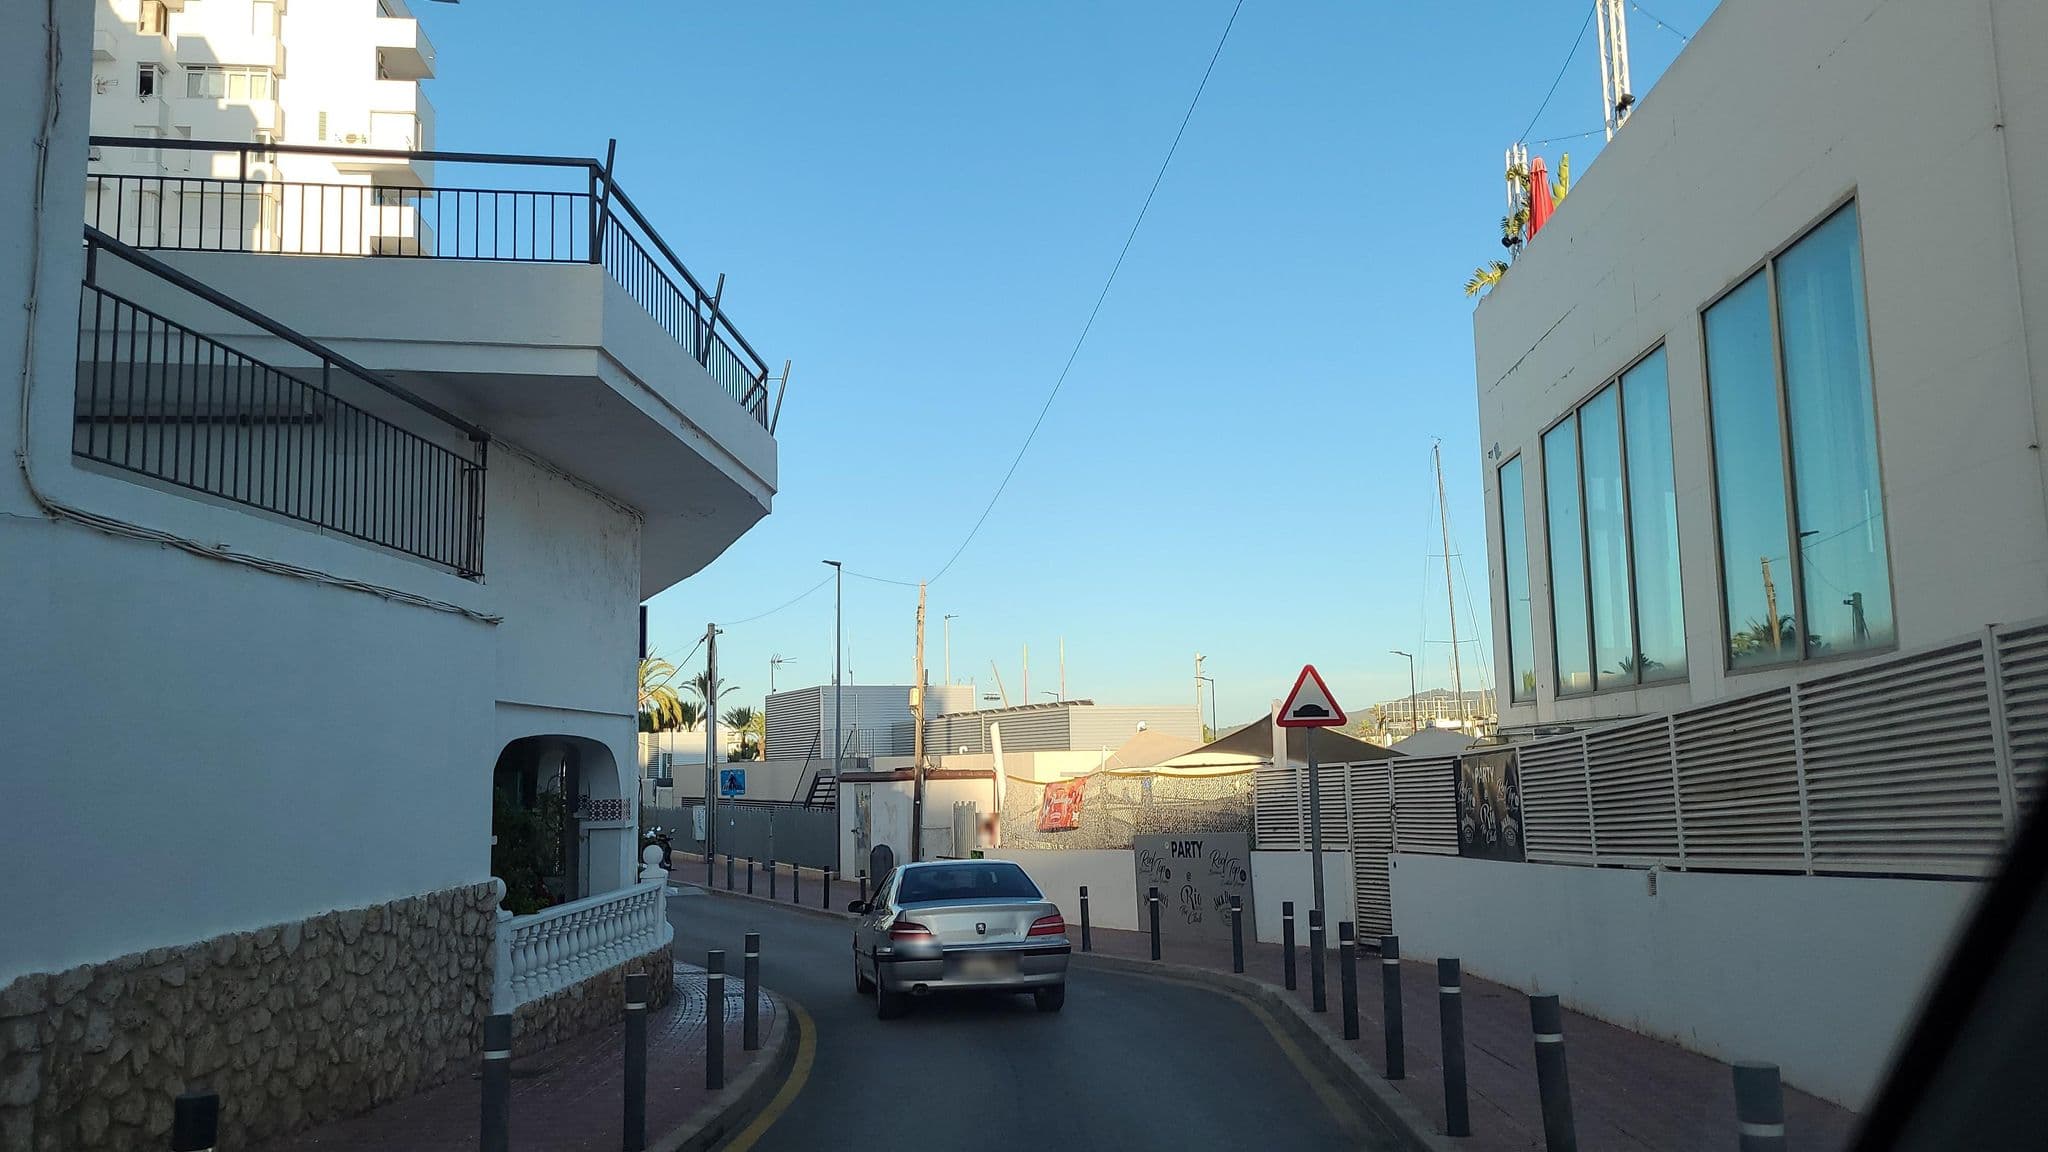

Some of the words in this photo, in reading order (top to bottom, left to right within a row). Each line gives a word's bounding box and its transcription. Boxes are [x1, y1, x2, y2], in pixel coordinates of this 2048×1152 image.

[1474, 766, 1494, 784] PARTY
[1171, 841, 1203, 858] PARTY
[1180, 884, 1202, 910] Rio
